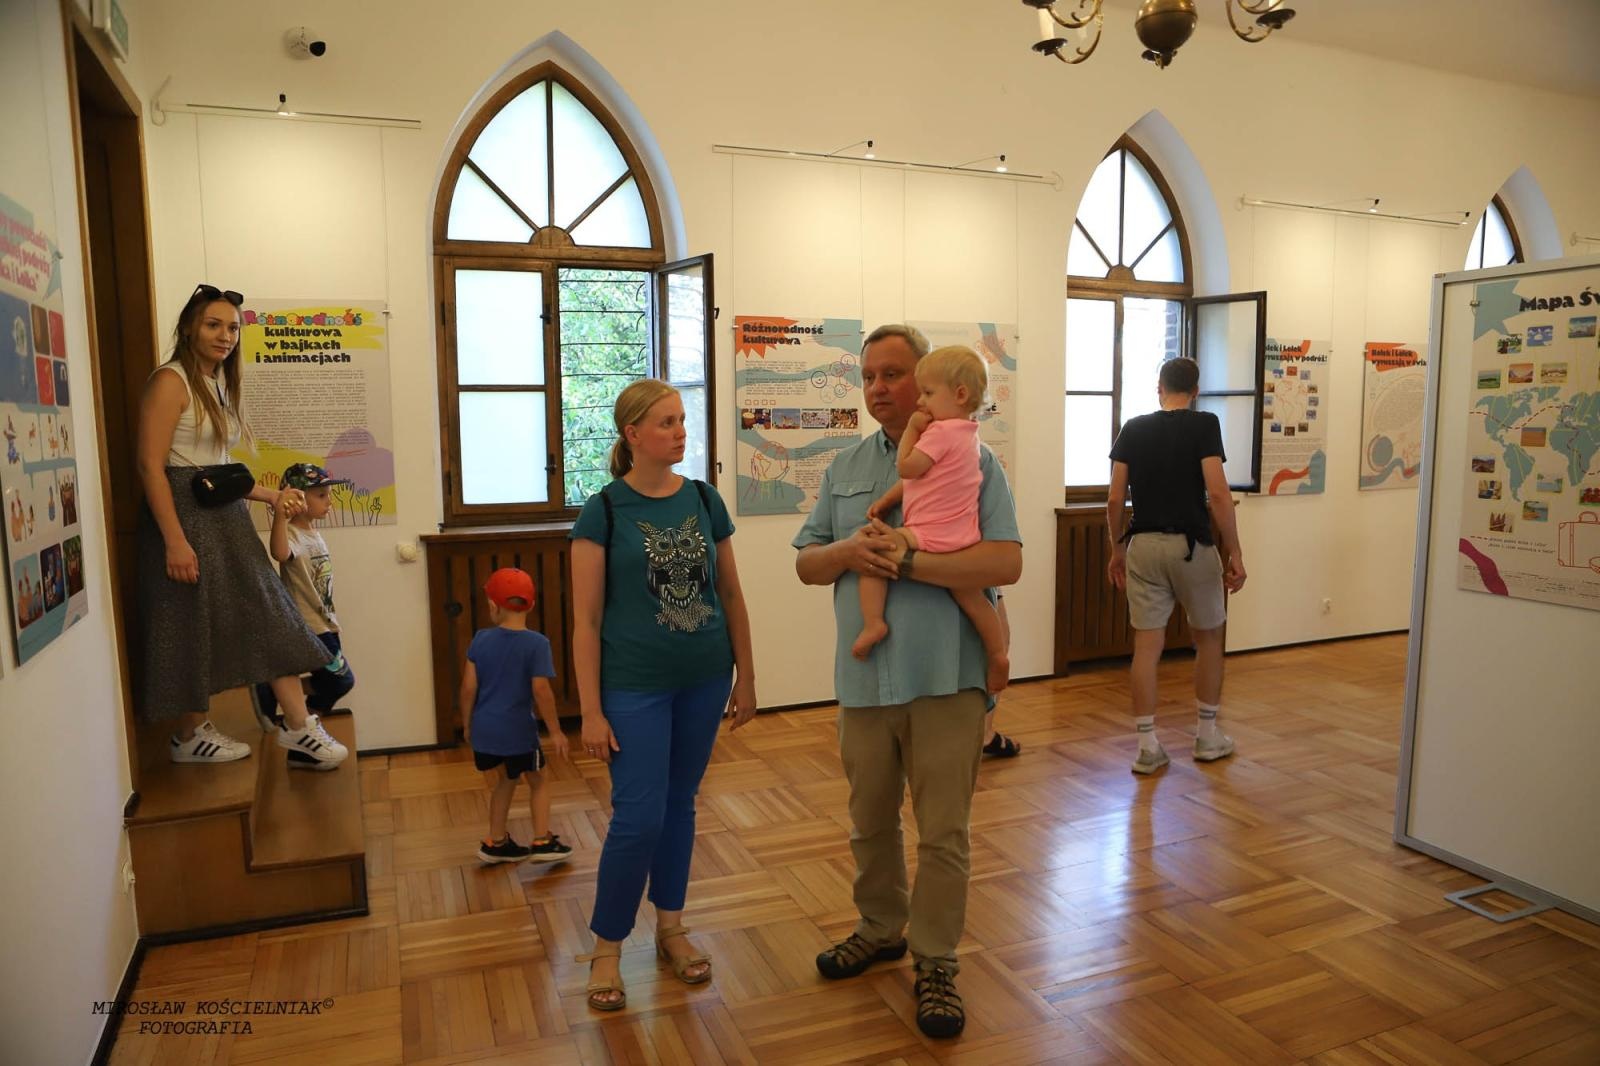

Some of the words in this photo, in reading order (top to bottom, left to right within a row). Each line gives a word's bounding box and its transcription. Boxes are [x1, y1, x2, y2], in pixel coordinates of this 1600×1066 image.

[1519, 296, 1575, 312] Mapa
[264, 327, 342, 337] kulturowa
[743, 322, 824, 335] Różnorodność
[264, 342, 277, 350] w
[280, 339, 341, 352] bajkach
[743, 335, 801, 345] kulturowa
[255, 352, 261, 363] i
[263, 352, 351, 365] animacjach
